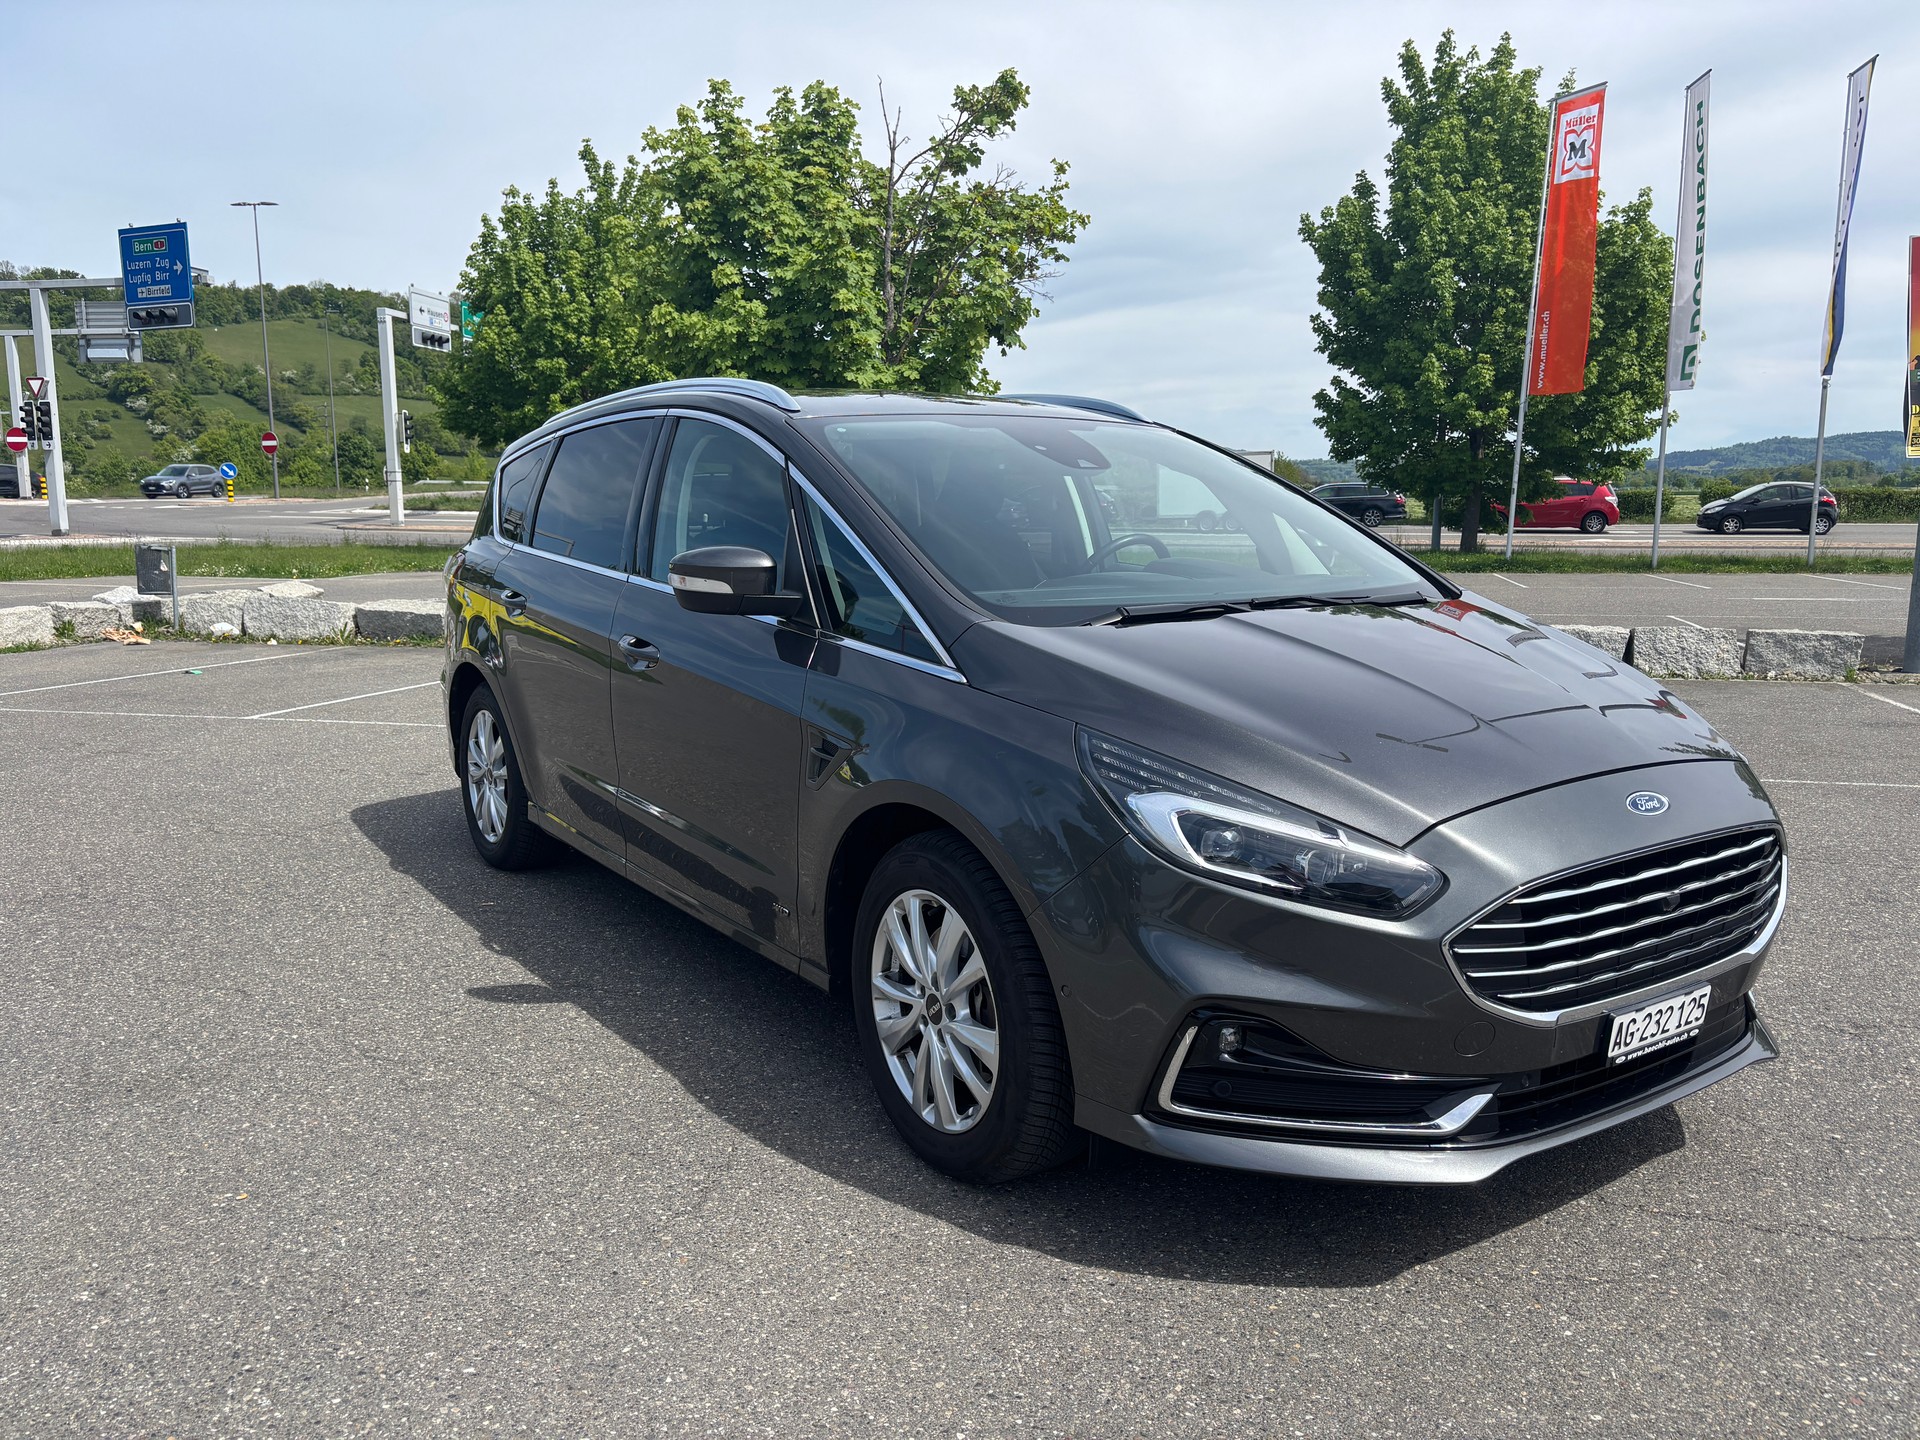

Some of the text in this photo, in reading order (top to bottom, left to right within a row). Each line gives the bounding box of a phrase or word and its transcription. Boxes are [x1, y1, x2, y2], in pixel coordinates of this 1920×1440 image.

[1565, 114, 1597, 130] Müller
[1567, 138, 1588, 161] M
[1689, 100, 1705, 334] DOSENBACH
[134, 242, 152, 252] Bern
[126, 257, 170, 270] Luzern Zug
[128, 270, 170, 284] Lupfig Birr
[147, 286, 170, 296] Birrfeld
[1537, 310, 1551, 389] www.mueller.ch
[1636, 796, 1661, 811] Ford
